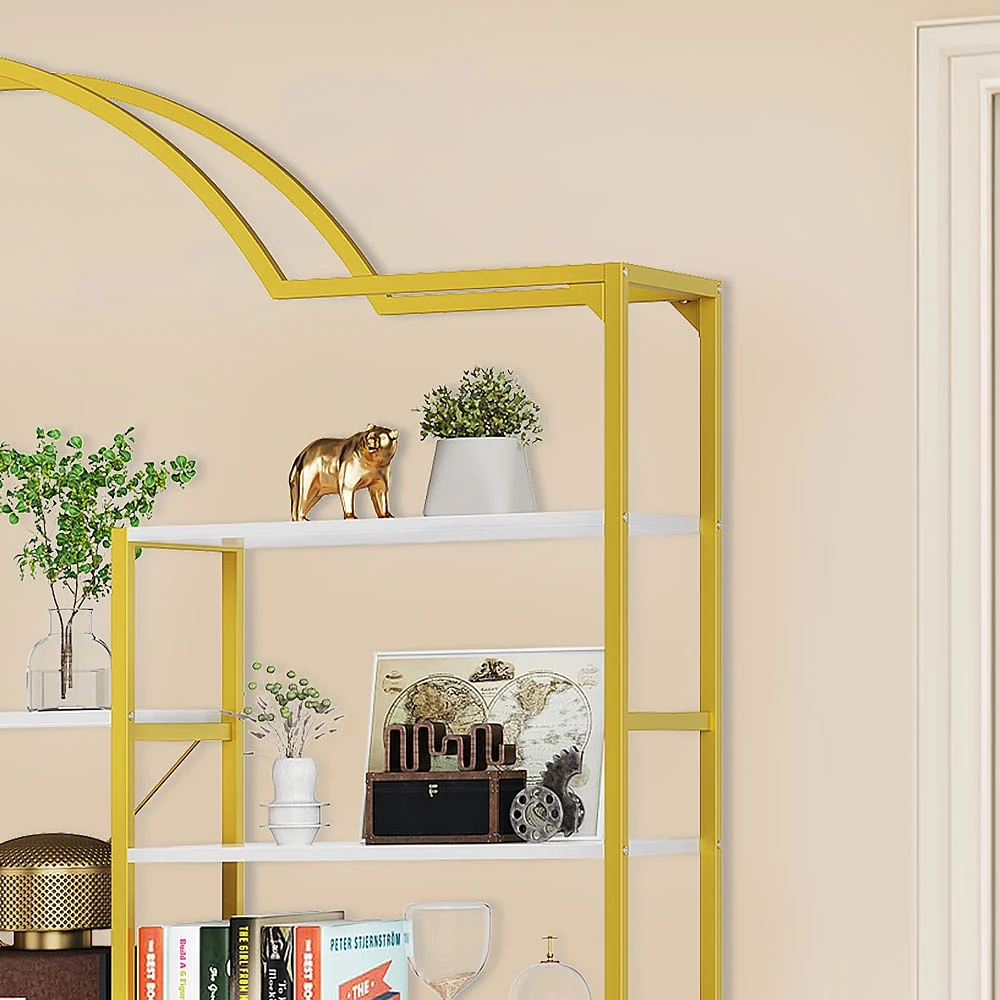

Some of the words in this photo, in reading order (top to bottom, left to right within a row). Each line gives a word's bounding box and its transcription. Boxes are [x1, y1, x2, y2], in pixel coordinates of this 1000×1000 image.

[239, 926, 248, 942] THE
[330, 936, 352, 951] PETER
[354, 931, 400, 950] STJERNSTRÖM
[239, 945, 248, 966] GIRL
[146, 953, 156, 980] BEST
[209, 966, 218, 981] The
[304, 954, 312, 980] BEST
[239, 968, 248, 992] FROM
[278, 980, 286, 994] To
[352, 982, 370, 1000] THE
